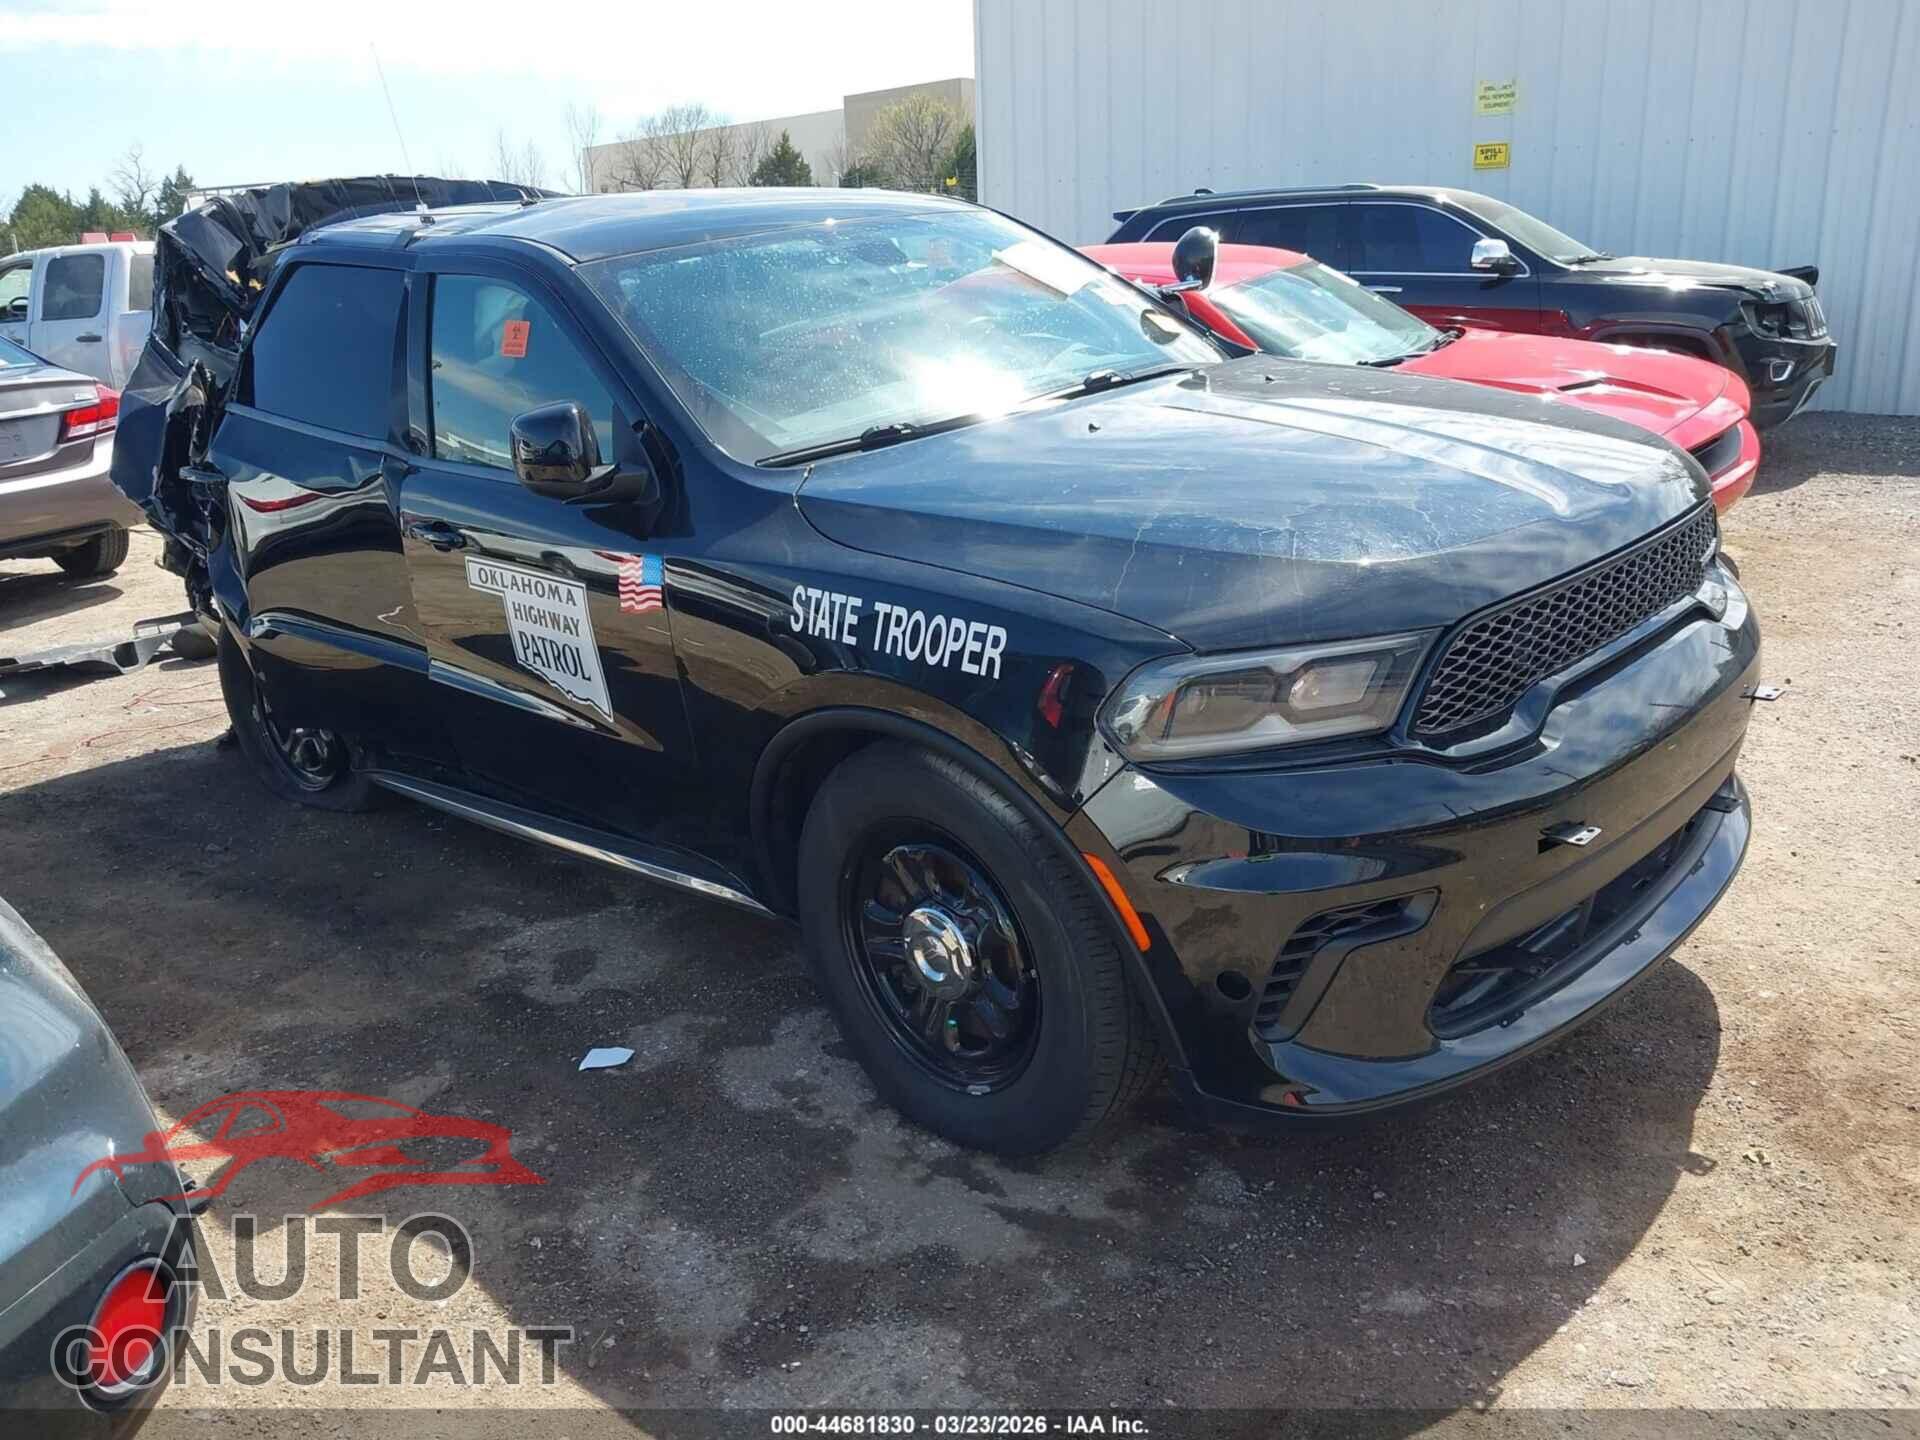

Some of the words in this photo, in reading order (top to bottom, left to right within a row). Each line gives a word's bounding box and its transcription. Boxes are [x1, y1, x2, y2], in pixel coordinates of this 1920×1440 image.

[1480, 147, 1504, 155] SPILL
[478, 567, 577, 606] OKLAHOMA
[511, 601, 580, 637] HIGHWAY
[790, 584, 863, 646] STATE
[873, 601, 1008, 680] TROOPER
[518, 631, 592, 682] PATROL
